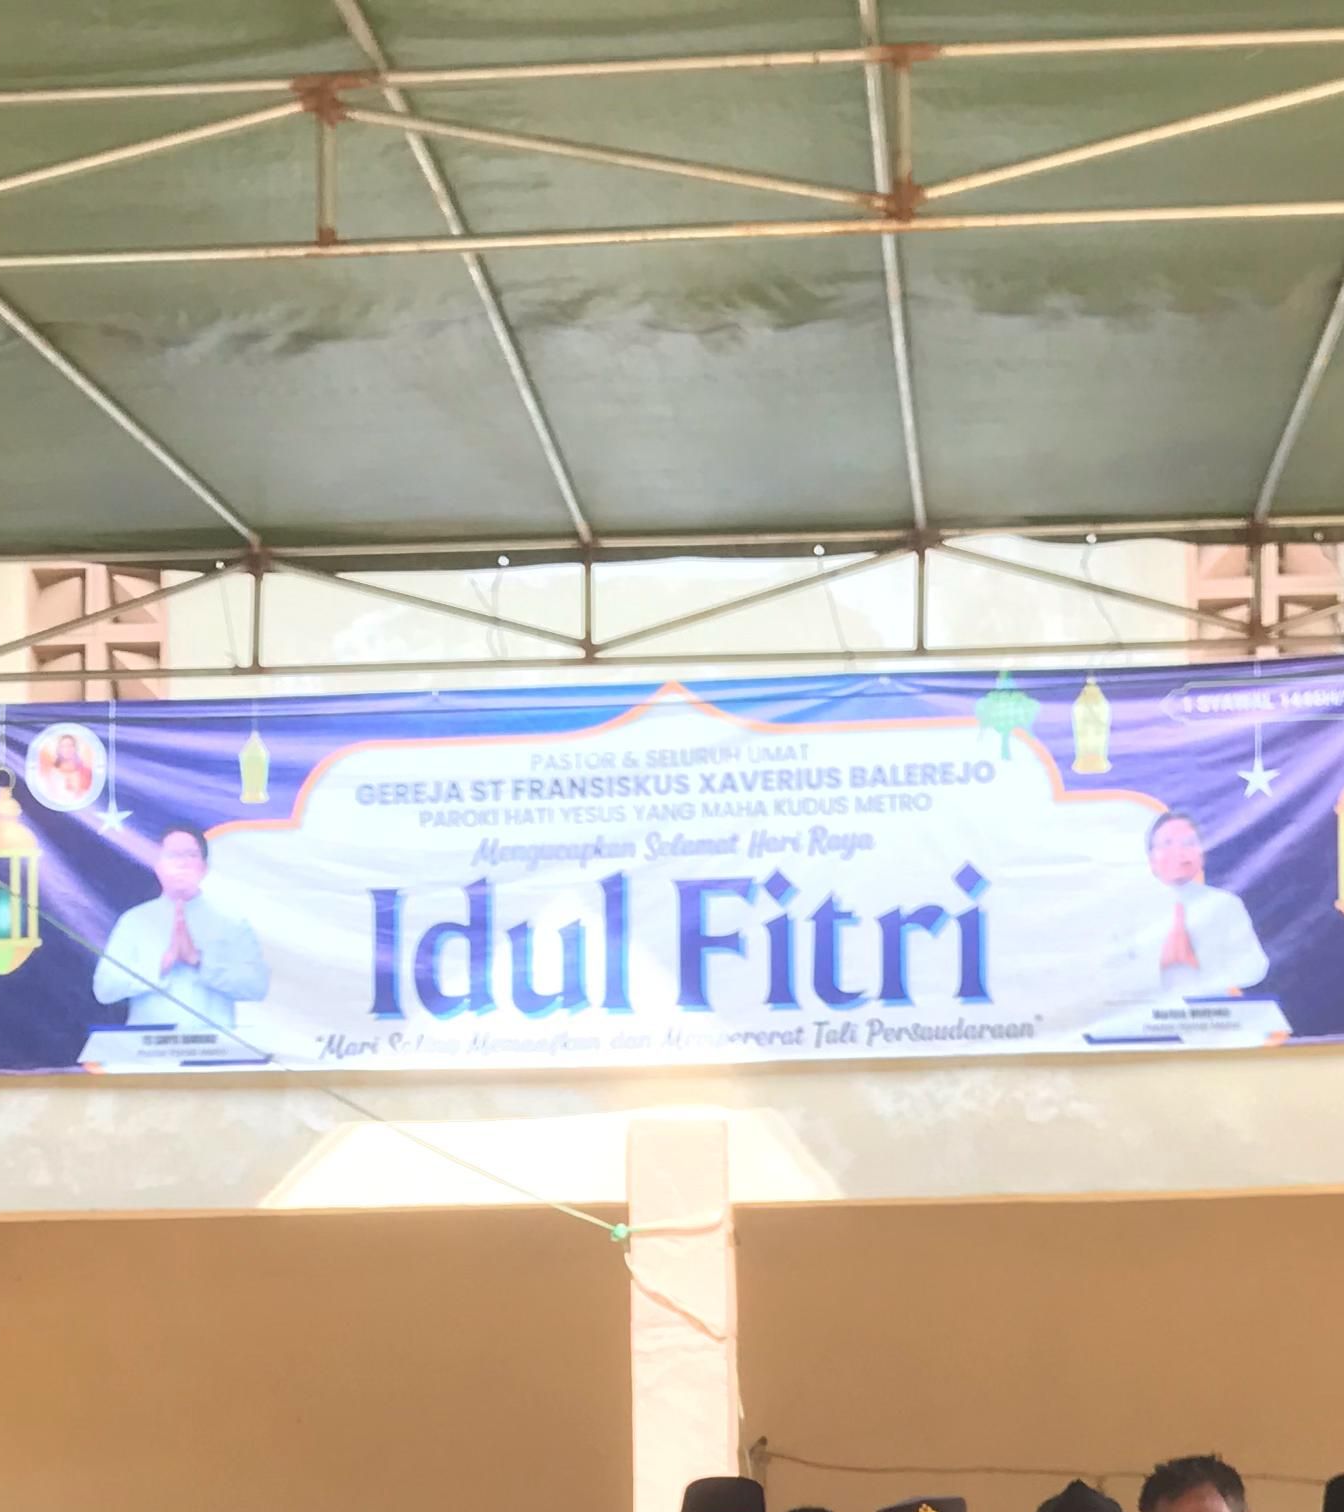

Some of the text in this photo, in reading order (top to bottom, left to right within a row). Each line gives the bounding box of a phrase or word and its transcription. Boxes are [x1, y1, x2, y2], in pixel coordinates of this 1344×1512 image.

[531, 744, 809, 772] PASTOR & SELURUH UMAT
[356, 760, 996, 806] GEREJA ST FRANSISKUS XAVERIUS BALEREJO
[419, 793, 933, 828] PAROKI HATI YESUS YANG MAHA KUDUS METRO
[470, 825, 876, 872] Mengucapkan Selamat Hari Raya
[368, 862, 993, 1020] Idul Fitri
[813, 1019, 859, 1050] Tali
